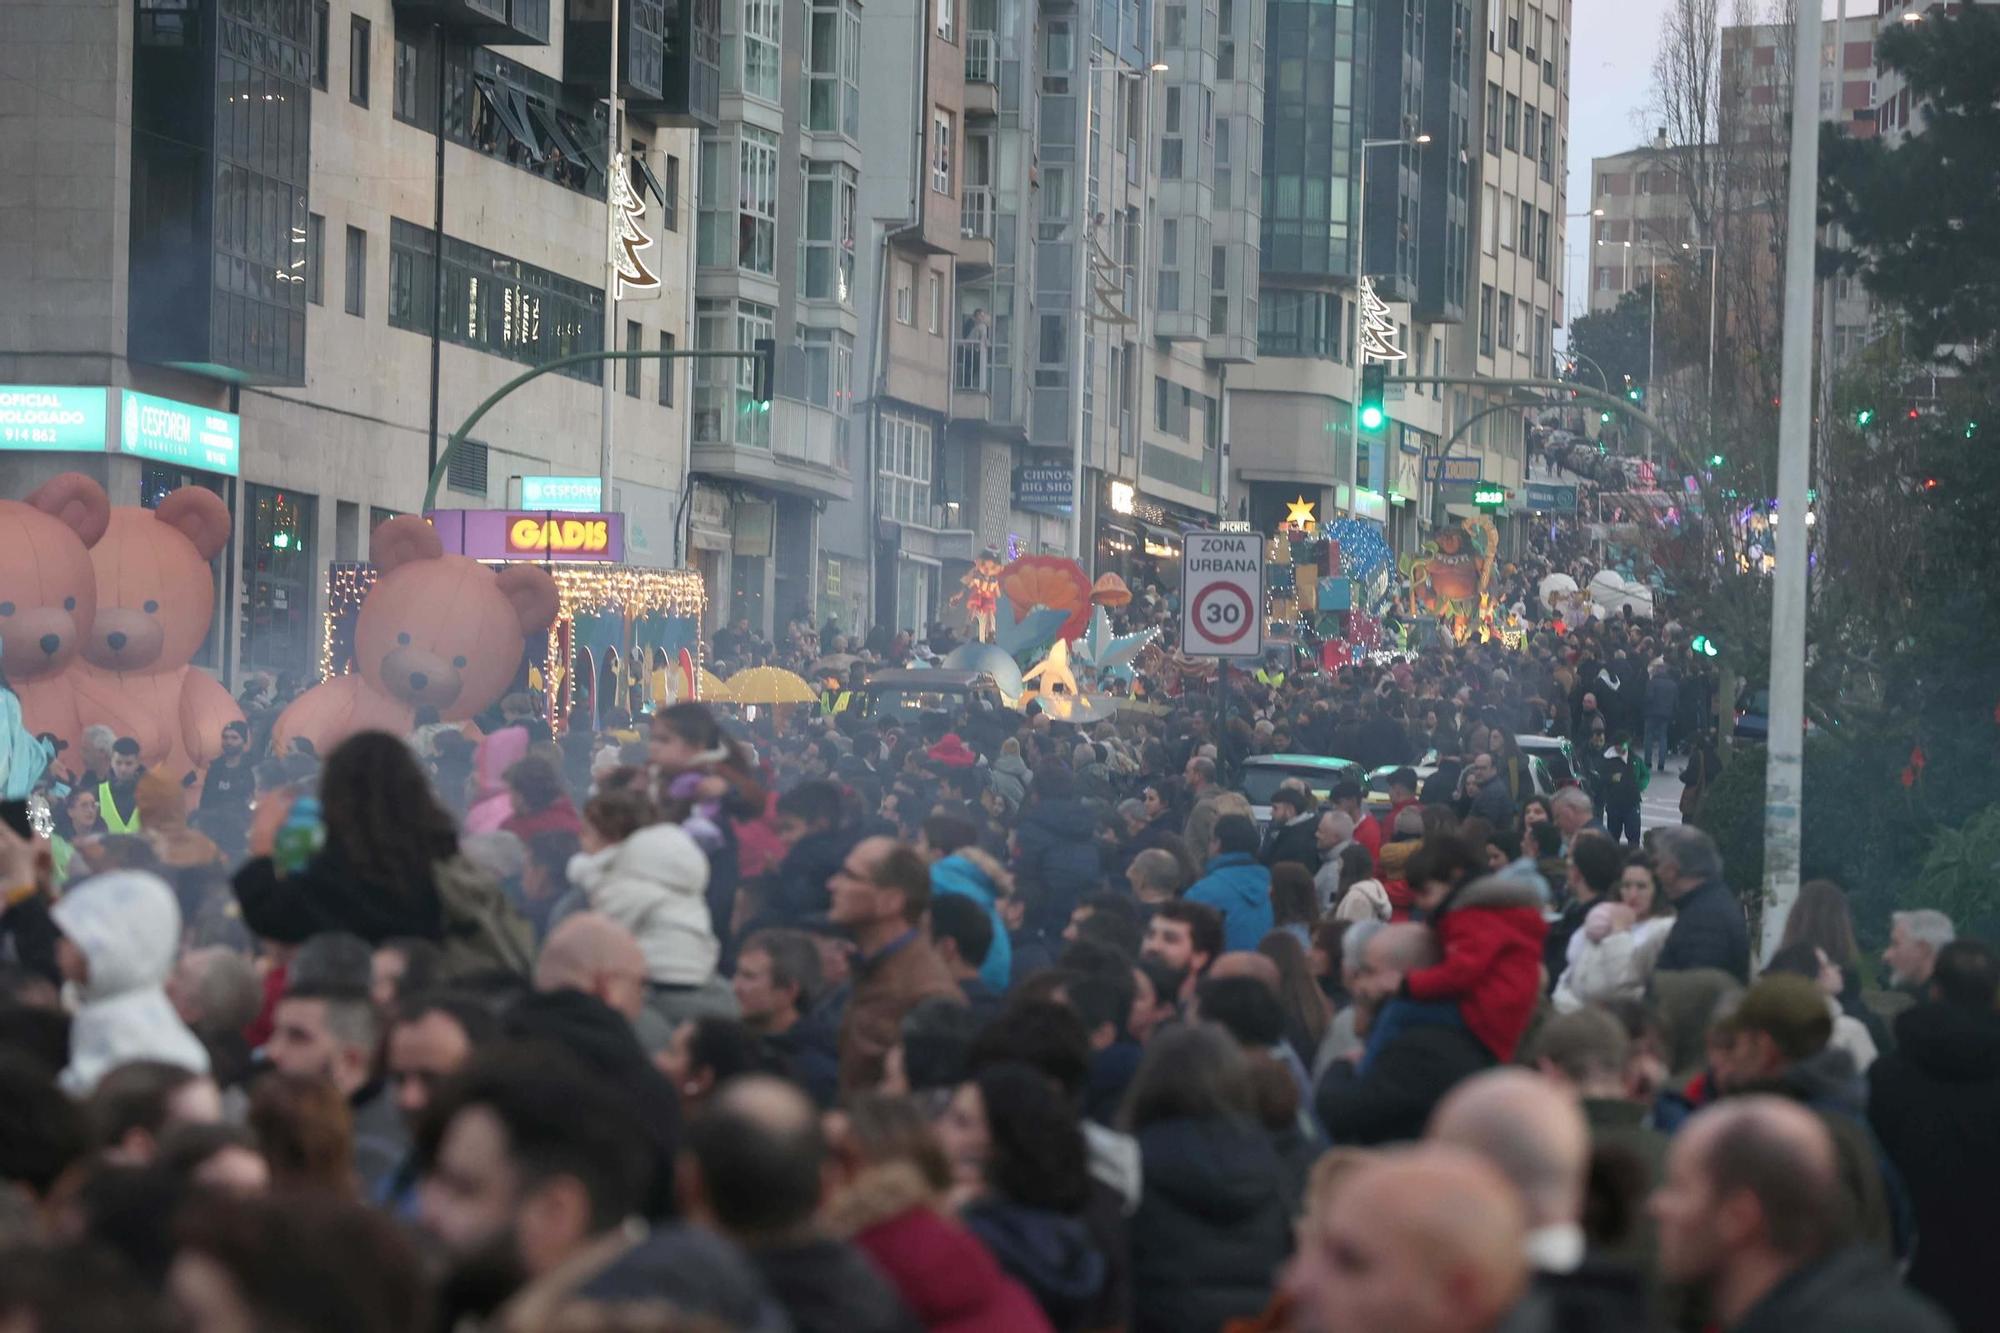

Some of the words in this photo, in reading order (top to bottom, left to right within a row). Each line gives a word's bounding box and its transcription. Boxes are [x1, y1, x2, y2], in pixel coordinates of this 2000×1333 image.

[0, 392, 62, 408] OFICIAL
[141, 405, 192, 445] CESFOREM
[5, 427, 30, 442] 914
[31, 427, 57, 442] 862
[1021, 481, 1042, 491] BIG
[1046, 481, 1072, 491] SHO
[1220, 521, 1249, 533] PICNIC
[510, 519, 608, 551] GADIS
[1201, 539, 1246, 553] ZONA
[1190, 558, 1257, 572] URBANA
[1206, 603, 1240, 624] 30
